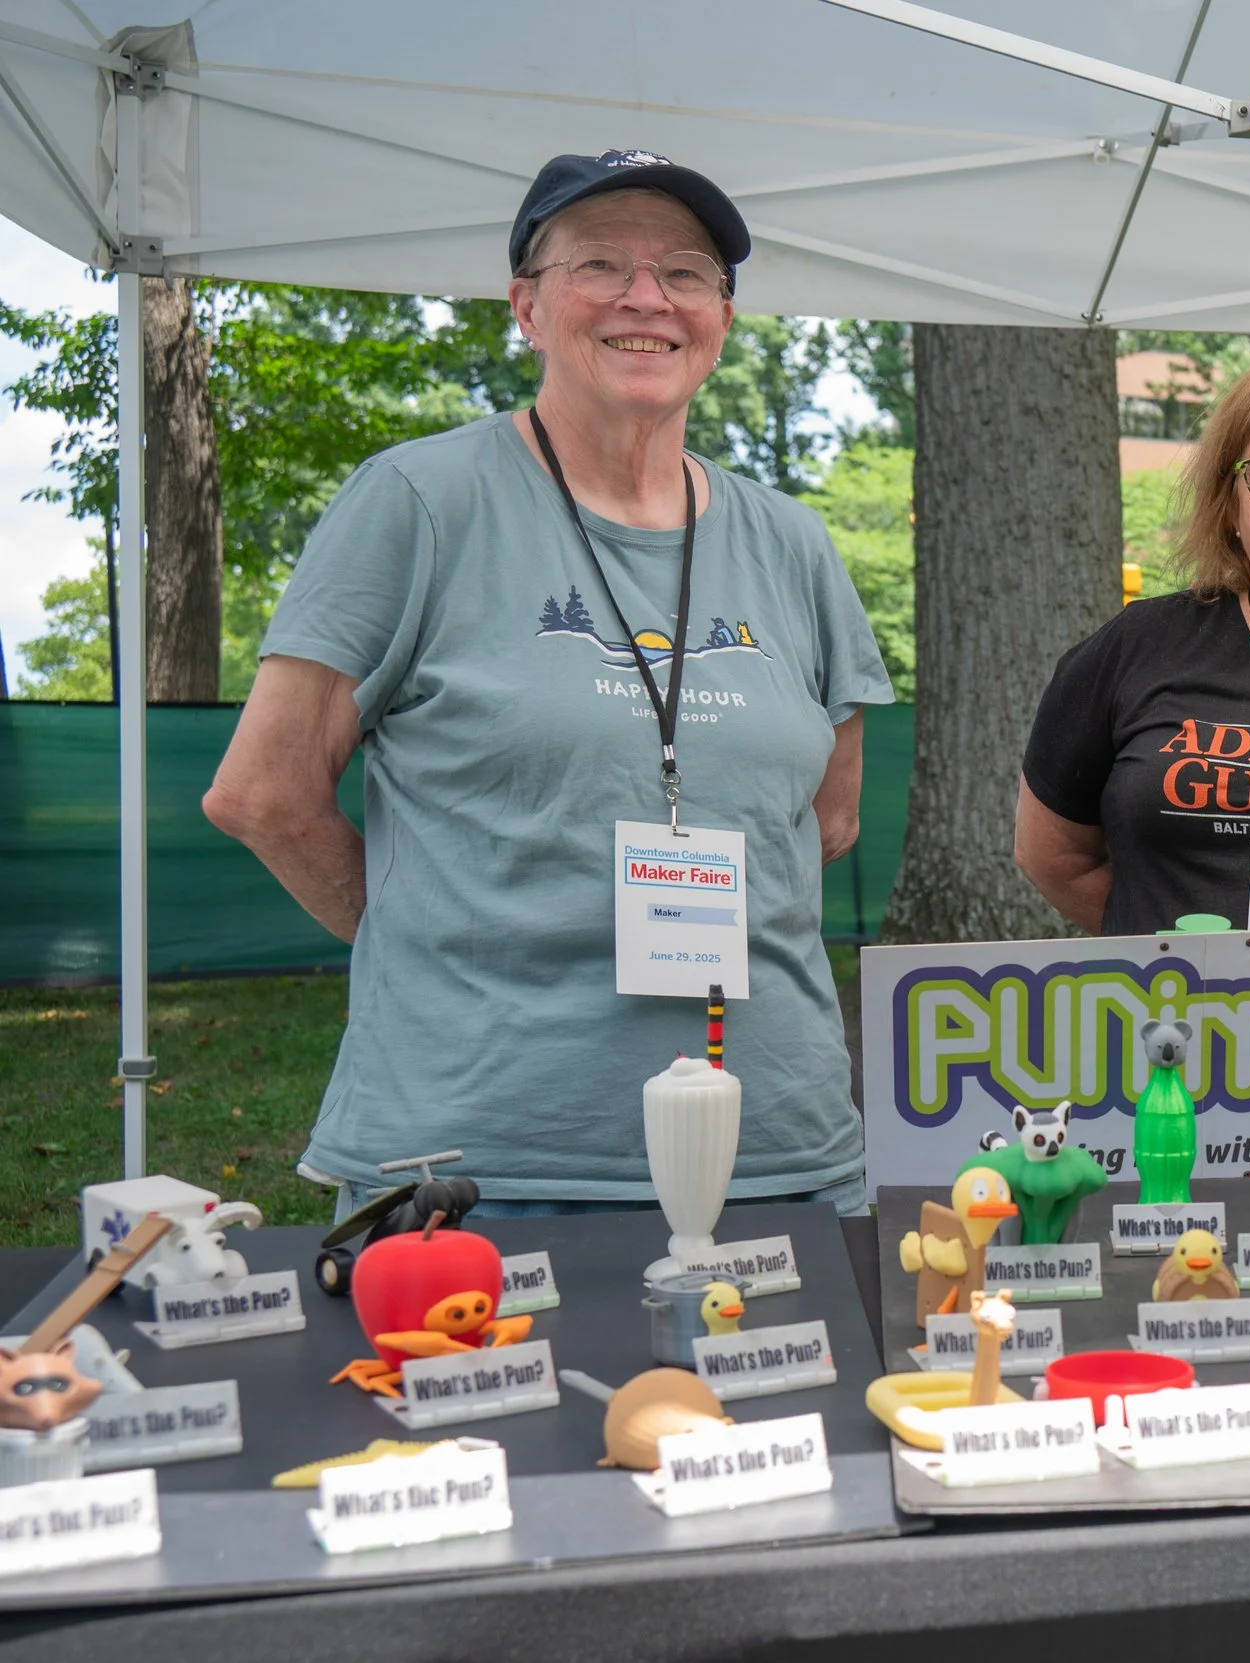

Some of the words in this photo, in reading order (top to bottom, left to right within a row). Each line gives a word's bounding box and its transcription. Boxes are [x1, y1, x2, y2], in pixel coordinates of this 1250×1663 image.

[680, 688, 746, 707] HOUR
[681, 712, 718, 722] GOOD
[624, 845, 679, 859] Downtown
[681, 850, 730, 863] Columbia
[631, 862, 686, 881] Maker
[690, 867, 731, 885] Faire
[654, 908, 682, 918] Maker
[649, 950, 673, 961] June
[695, 953, 721, 963] 2025
[1118, 1218, 1161, 1237] What's
[1163, 1217, 1184, 1236] the
[733, 1256, 755, 1276] the
[756, 1251, 788, 1273] Pun?
[985, 1261, 1031, 1281] What's
[1034, 1260, 1056, 1279] the
[1059, 1258, 1092, 1279] Pun?
[513, 1267, 546, 1290] Pun?
[165, 1298, 221, 1322] What's
[223, 1294, 249, 1315] the
[252, 1287, 291, 1314] Pun?
[934, 1332, 977, 1354] What'
[1017, 1327, 1053, 1350] Pun?
[1145, 1320, 1196, 1342] What's
[1199, 1317, 1222, 1339] the
[704, 1350, 755, 1376] What's
[758, 1346, 783, 1368] the
[785, 1339, 822, 1365] Pun?
[413, 1372, 472, 1401] What's
[475, 1367, 501, 1392] the
[504, 1359, 544, 1386] Pun?
[88, 1414, 141, 1442] hat's
[145, 1410, 175, 1435] the
